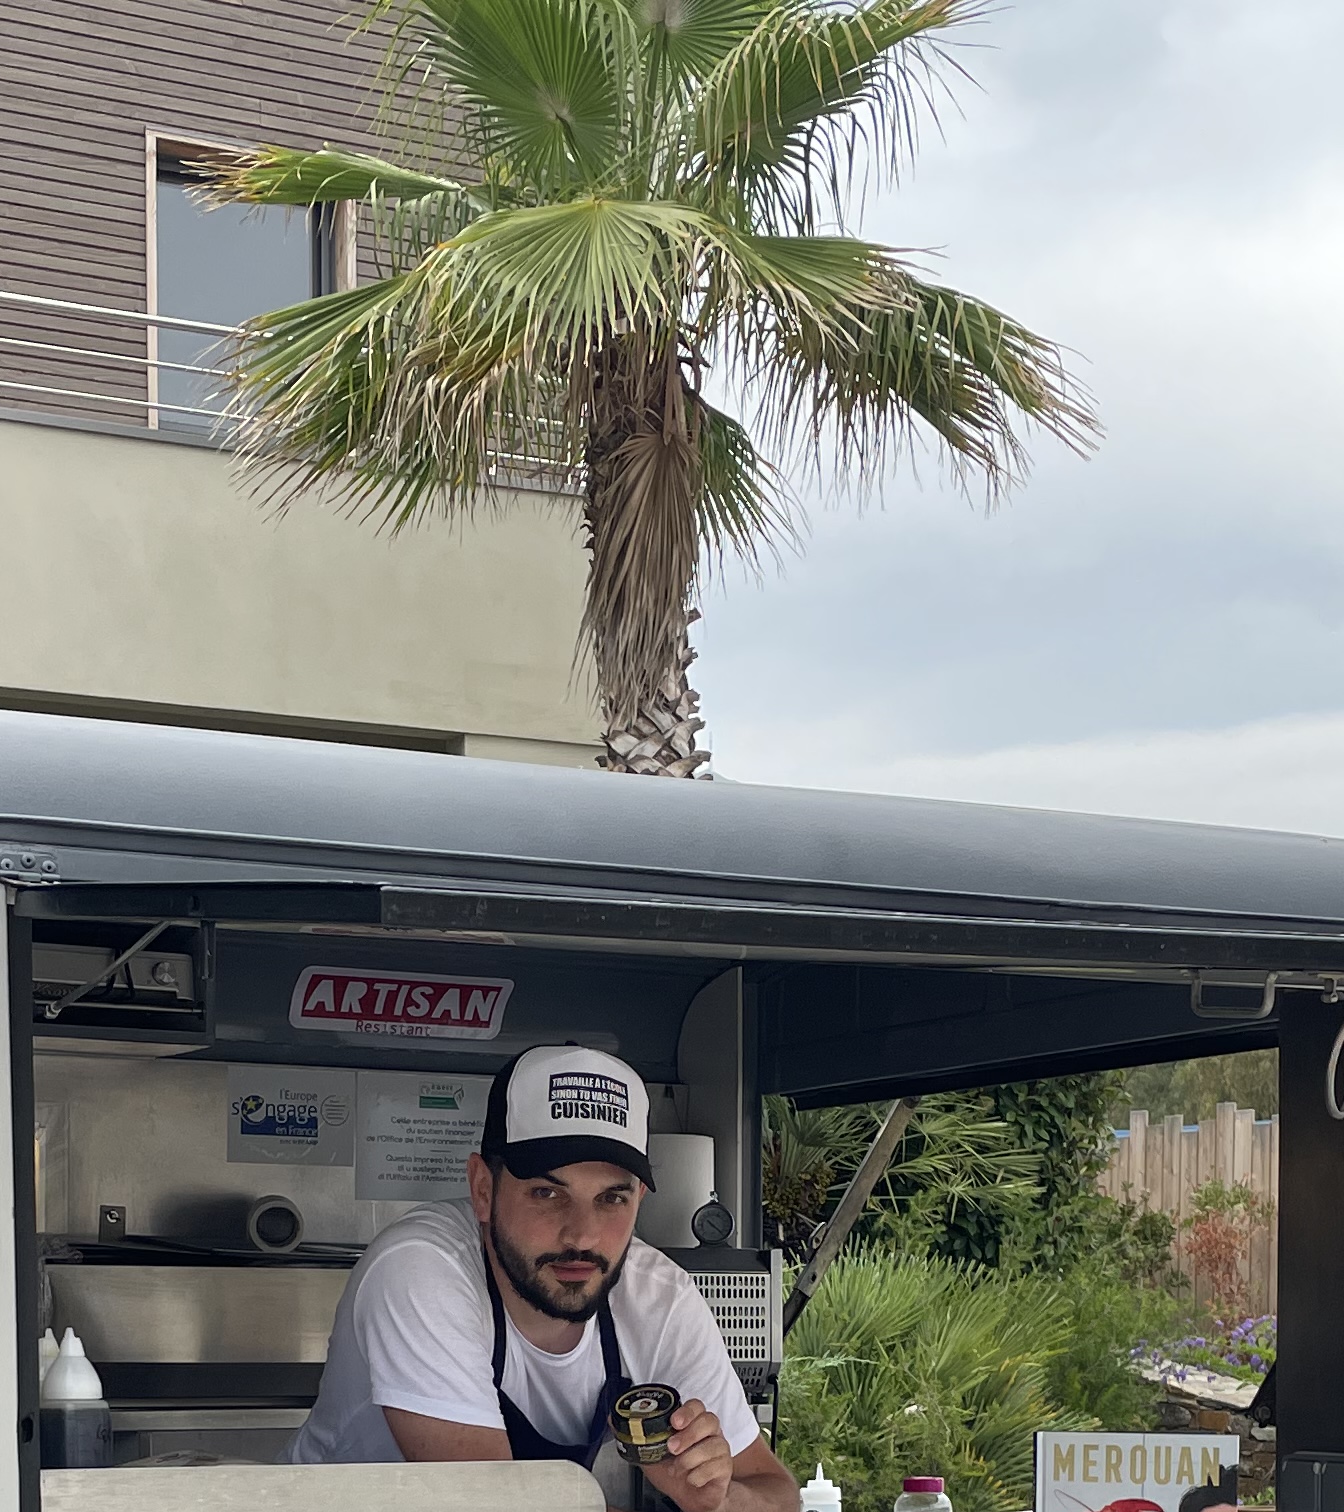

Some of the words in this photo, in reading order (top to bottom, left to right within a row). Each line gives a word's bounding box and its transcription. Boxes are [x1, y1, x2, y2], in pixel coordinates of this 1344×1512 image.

[304, 979, 498, 1023] ARTISAN
[356, 1019, 432, 1037] Resistant
[279, 1088, 318, 1104] l'Europe
[551, 1101, 627, 1129] CUISINIER
[1053, 1443, 1221, 1487] MEROUAN
